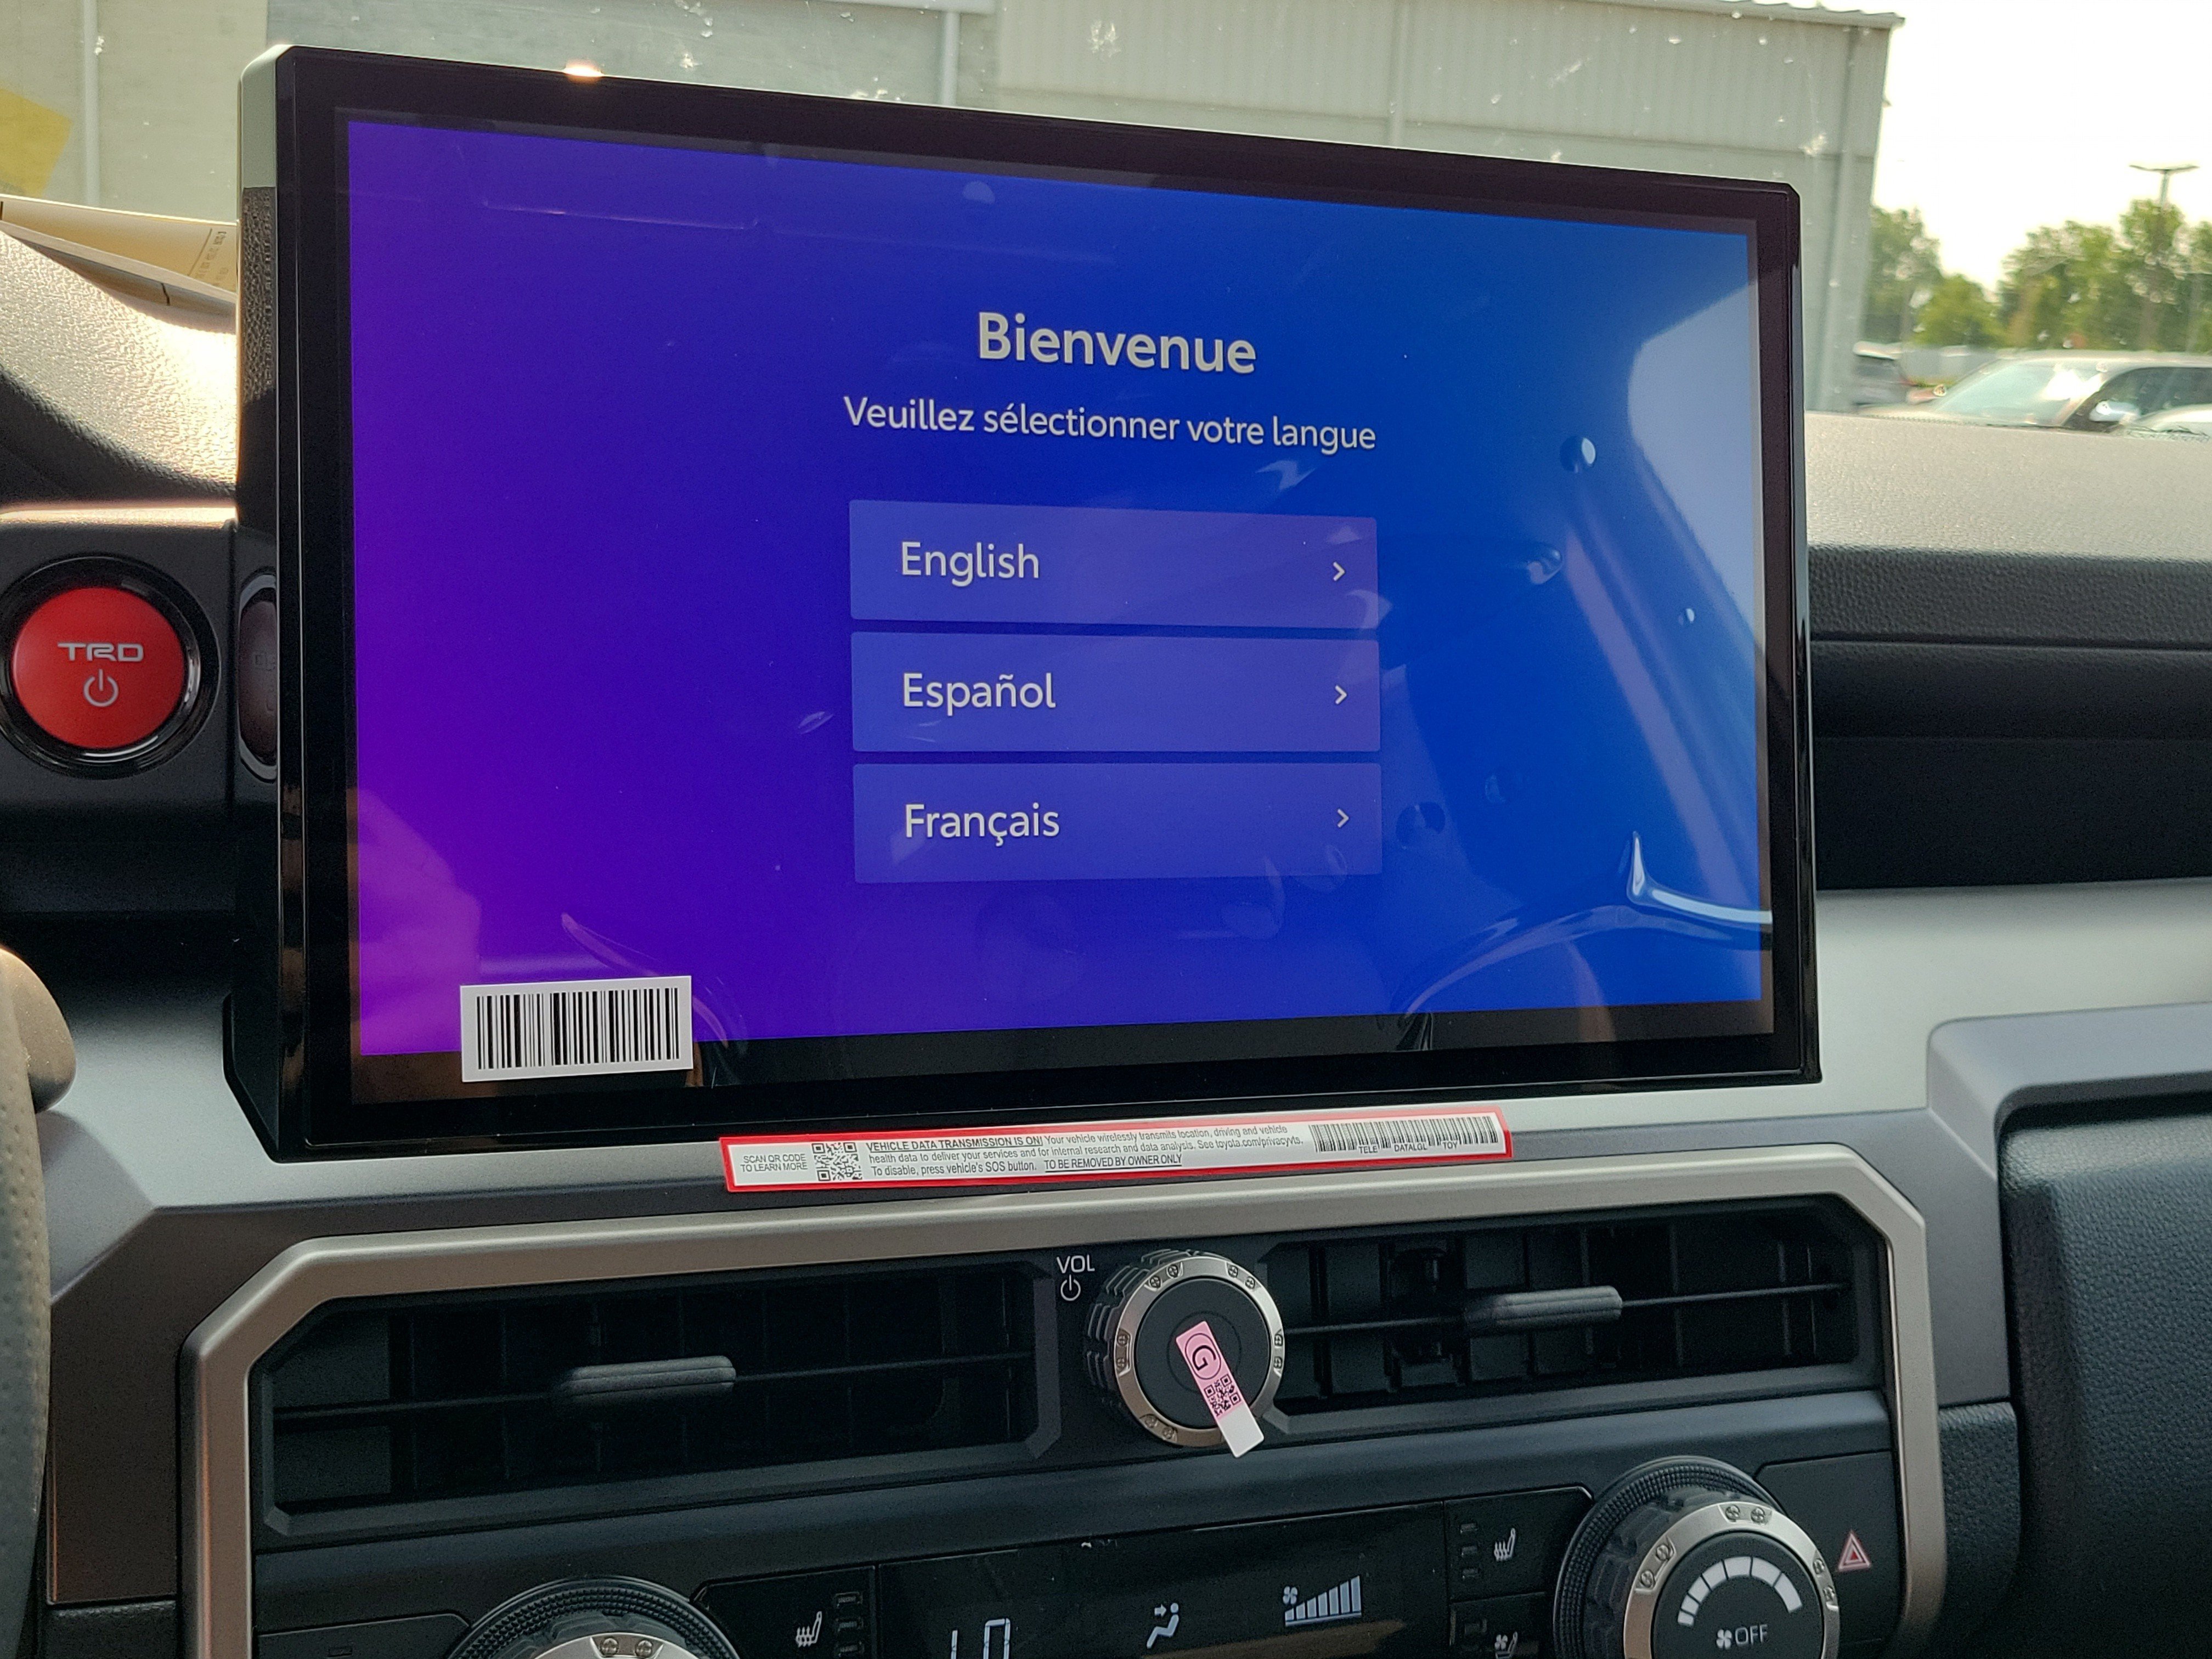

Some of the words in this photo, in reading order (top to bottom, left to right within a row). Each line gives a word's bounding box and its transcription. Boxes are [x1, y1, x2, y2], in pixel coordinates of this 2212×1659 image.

[978, 311, 1257, 374] Bienvenue
[844, 396, 974, 432] Veuillez
[983, 404, 1180, 440] sélectionner
[1187, 417, 1264, 445] votre
[1272, 416, 1376, 456] langue
[900, 540, 1040, 587] English
[57, 642, 144, 663] TRD
[902, 672, 1056, 716] Español
[904, 802, 1060, 846] Français
[866, 1141, 910, 1151] VEHICLE
[911, 1139, 938, 1150] DATA
[939, 1137, 1012, 1149] TRANSMISSION
[1014, 1137, 1024, 1145] IS
[1044, 1135, 1064, 1144] Your
[1066, 1133, 1096, 1143] vehicle
[1097, 1131, 1137, 1142] wirelessly
[1139, 1129, 1177, 1141] transmits
[1178, 1128, 1212, 1138] location,
[1214, 1126, 1242, 1137] driving
[1243, 1125, 1258, 1135] and
[1259, 1124, 1288, 1134] vehicle
[1358, 1145, 1378, 1154] TELE
[1442, 1141, 1459, 1150] TOY
[743, 1154, 766, 1164] SCAN
[768, 1154, 781, 1163] QR
[783, 1153, 806, 1162] CODE
[869, 1153, 896, 1164] health
[898, 1153, 918, 1163] data
[920, 1153, 929, 1162] to
[932, 1151, 960, 1161] deliver
[962, 1152, 980, 1163] your
[983, 1148, 1018, 1159] services
[1020, 1147, 1036, 1157] and
[1037, 1147, 1049, 1156] for
[1051, 1146, 1083, 1156] internal
[1084, 1144, 1121, 1154] research
[1123, 1143, 1138, 1153] and
[1140, 1142, 1159, 1152] data
[1160, 1141, 1196, 1152] analysis.
[1197, 1139, 1215, 1149] See
[741, 1164, 753, 1172] TO
[754, 1163, 782, 1172] LEARN
[783, 1162, 808, 1171] MORE
[871, 1165, 883, 1176] To
[884, 1164, 919, 1176] disable,
[921, 1165, 945, 1177] press
[946, 1161, 984, 1173] vehicle's
[985, 1160, 1006, 1172] SOS
[1007, 1159, 1037, 1171] button.
[1044, 1159, 1056, 1170] TO
[1058, 1158, 1070, 1169] BE
[1071, 1156, 1114, 1169] REMOVED
[1115, 1155, 1126, 1166] BY
[1127, 1154, 1160, 1166] OWNER
[1160, 1153, 1182, 1165] ONLY
[1056, 1254, 1096, 1274] VOL
[1192, 1344, 1217, 1371] G
[1735, 1624, 1768, 1646] OFF
